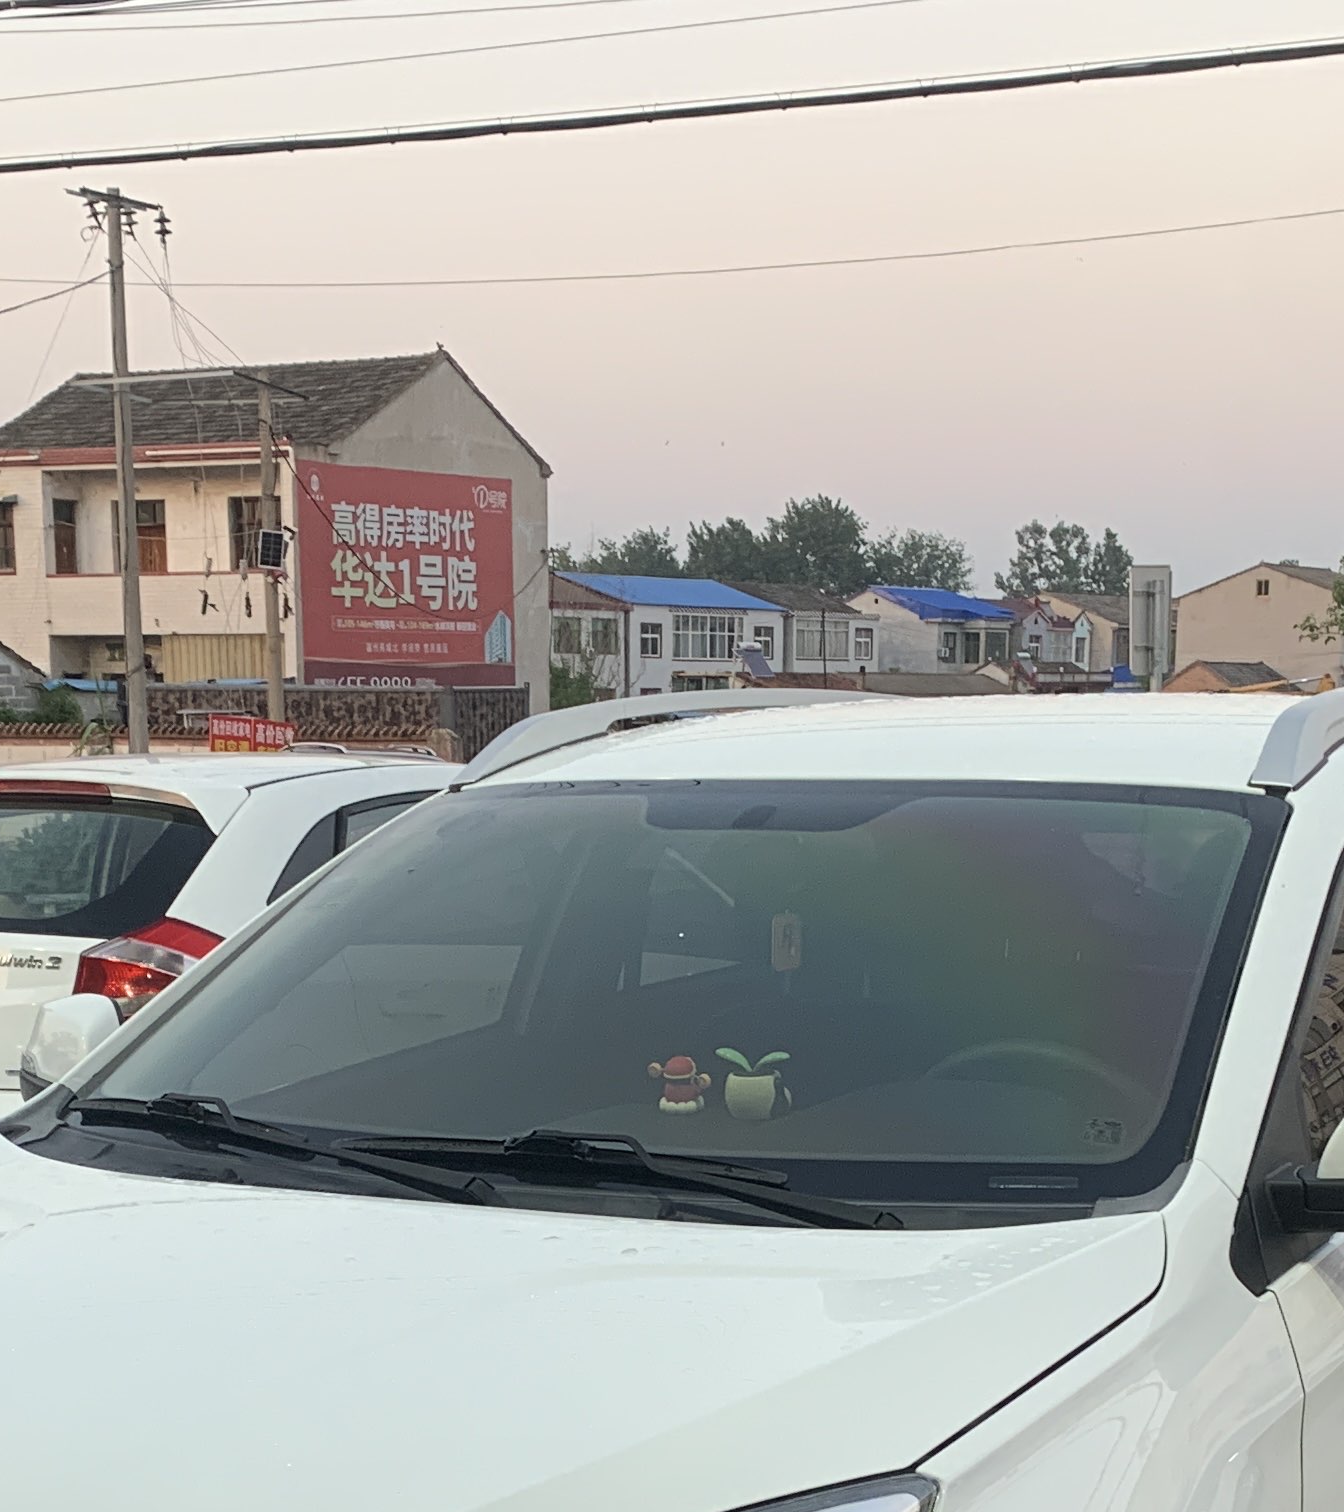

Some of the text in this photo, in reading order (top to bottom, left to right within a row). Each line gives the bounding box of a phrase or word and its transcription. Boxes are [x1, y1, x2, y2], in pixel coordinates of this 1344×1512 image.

[330, 501, 475, 551] 高得房率时代
[330, 550, 478, 612] 华达1号院
[45, 956, 62, 970] 2
